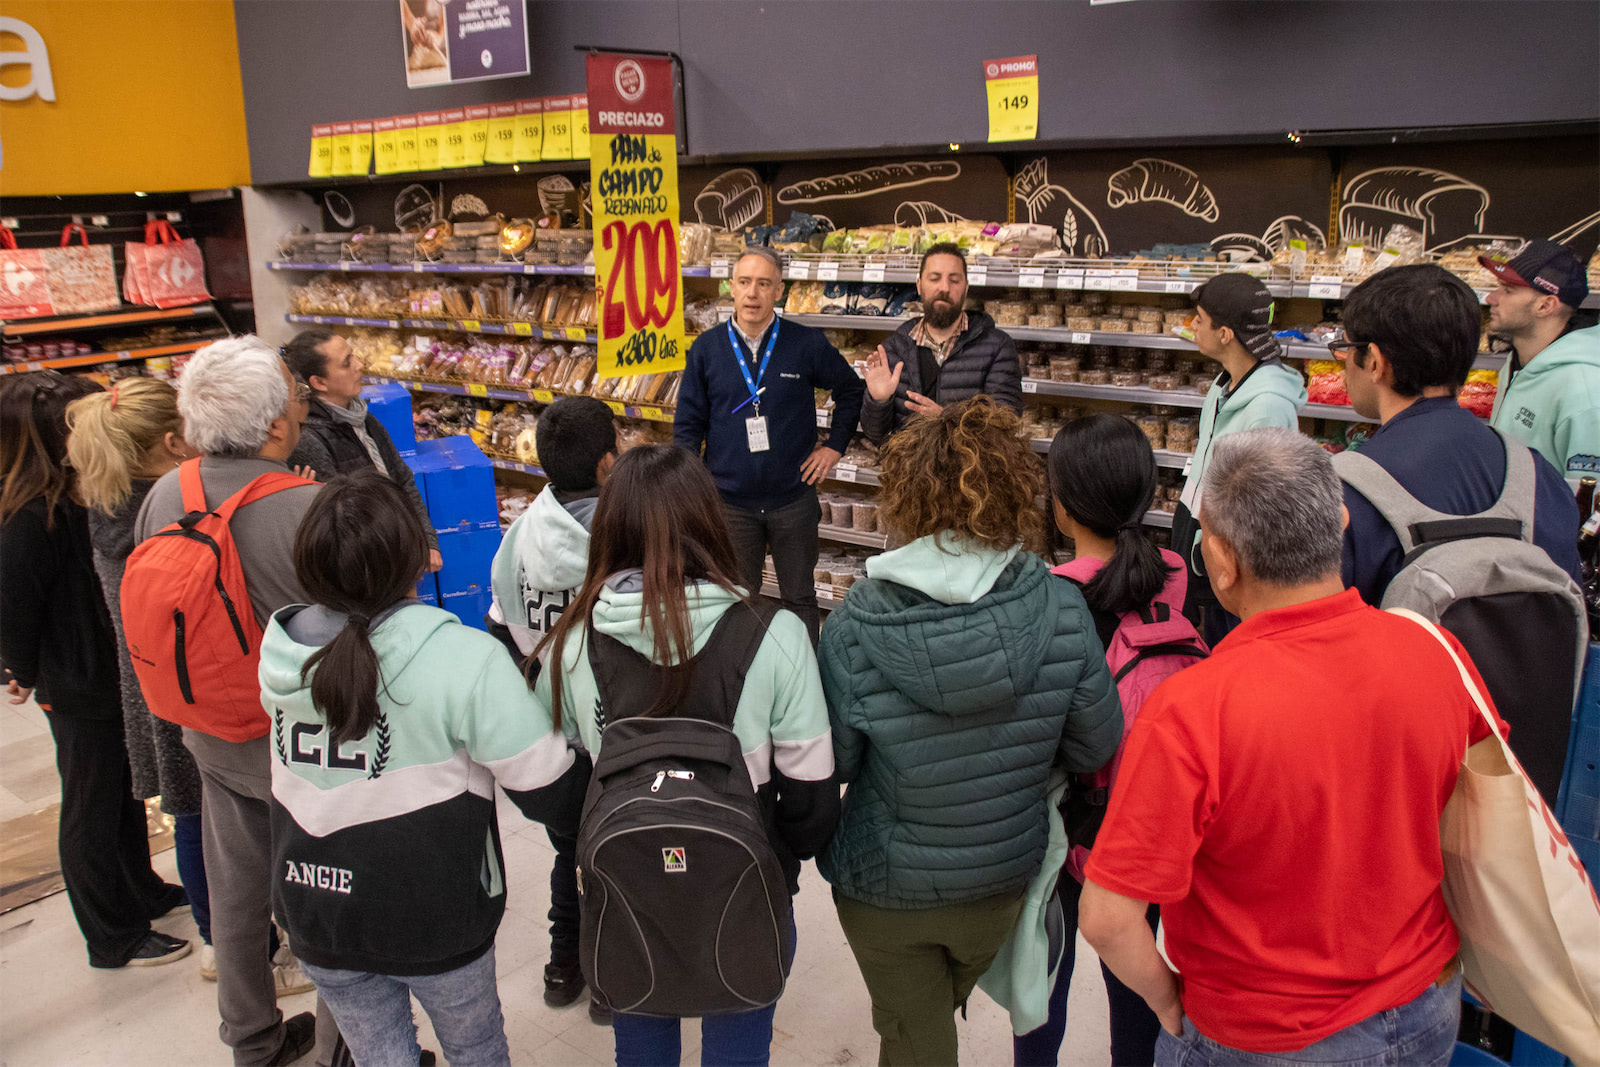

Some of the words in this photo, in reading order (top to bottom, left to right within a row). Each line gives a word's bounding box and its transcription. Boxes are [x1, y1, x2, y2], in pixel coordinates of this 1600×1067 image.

[1000, 61, 1035, 73] PROMO!
[598, 110, 665, 127] PRECIAZO
[610, 133, 647, 167] PAN
[648, 145, 662, 163] de
[598, 166, 663, 198] CAMPO
[604, 195, 668, 216] REBANADO
[285, 860, 353, 895] ANGIE
